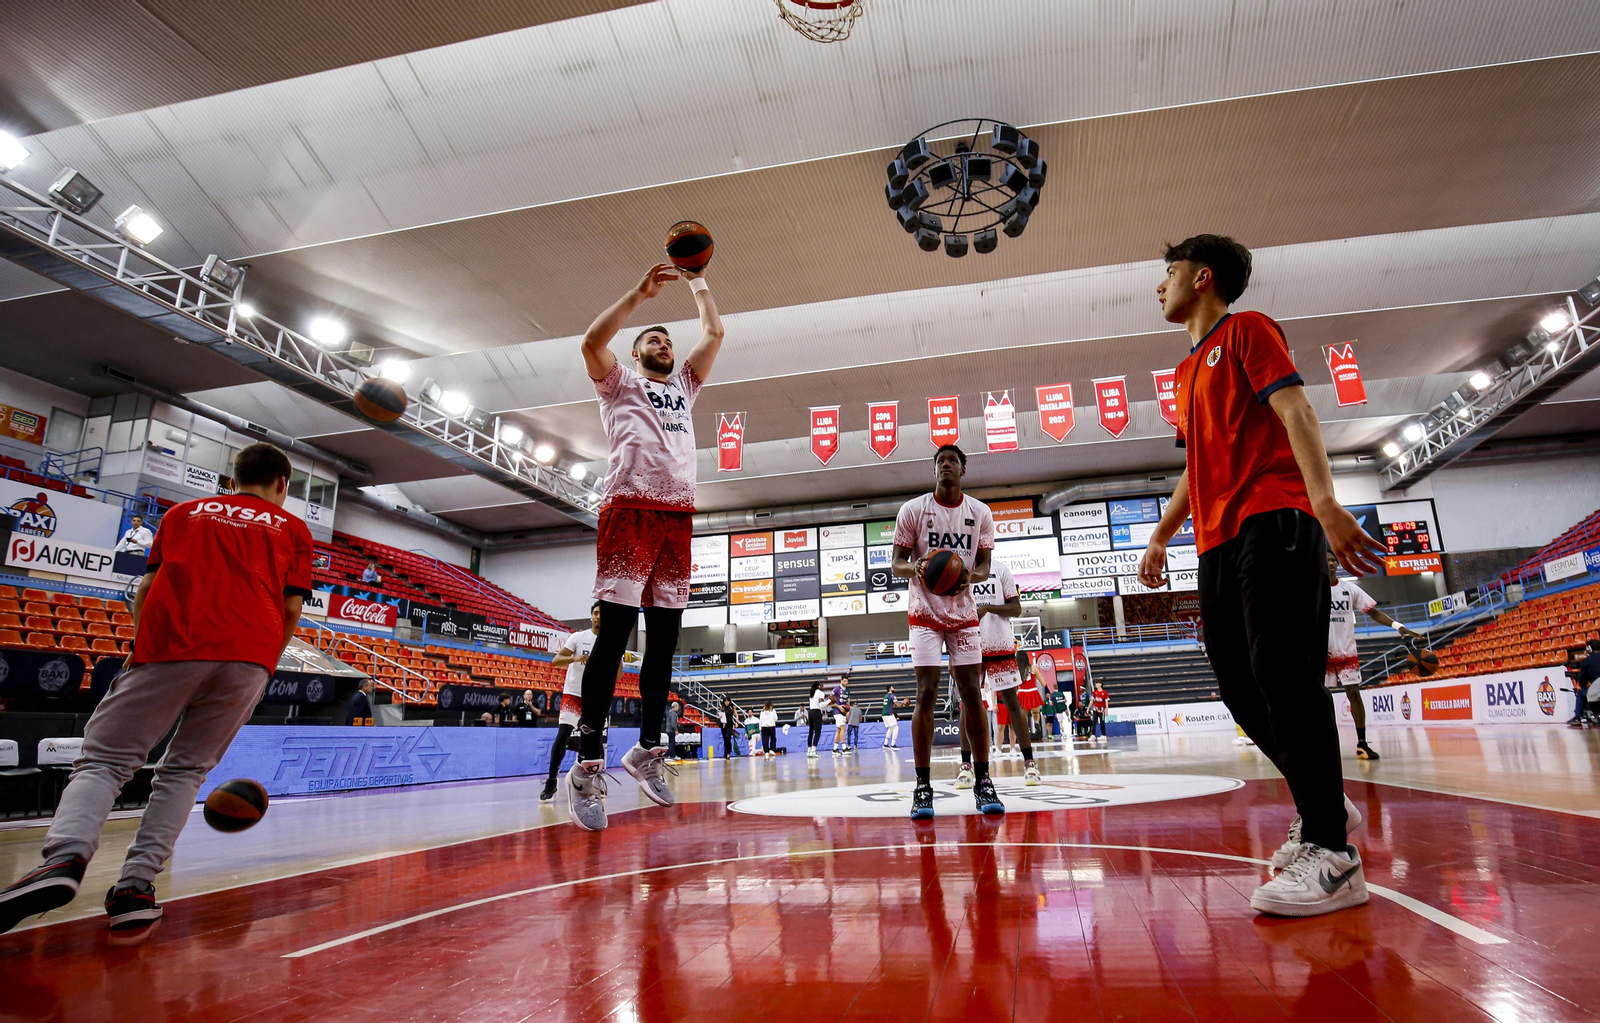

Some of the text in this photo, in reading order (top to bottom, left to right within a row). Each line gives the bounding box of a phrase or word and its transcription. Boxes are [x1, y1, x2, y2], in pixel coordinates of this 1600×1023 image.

[1046, 393, 1063, 402] LLIGA
[1102, 388, 1120, 397] LLIGA
[1160, 391, 1175, 400] CATAL
[647, 392, 686, 411] BAX
[1041, 401, 1071, 411] CATALANA
[1106, 399, 1119, 407] ACB
[933, 405, 953, 414] LLIGA
[817, 417, 832, 425] LLIGA
[876, 413, 891, 421] COPA
[937, 417, 950, 425] LEB
[1049, 416, 1066, 424] 2021
[813, 426, 837, 435] CATALANA
[873, 423, 883, 431] DEL
[187, 467, 216, 480] JUANOLA
[189, 502, 287, 528] JOYSAT
[1064, 509, 1102, 518] canonge
[18, 527, 46, 537] ANRESA
[996, 522, 1025, 534] GCT
[929, 532, 972, 549] BAXI
[1063, 533, 1108, 542] FRAMUN
[1388, 536, 1398, 544] 00
[1418, 534, 1428, 542] 00
[36, 545, 112, 572] AIGNEP
[1399, 558, 1440, 567] ESTRELLA
[777, 559, 815, 570] sensus
[1078, 565, 1117, 576] sarsa
[844, 572, 860, 580] GLS
[973, 584, 995, 595] AXI
[1020, 592, 1053, 600] CLARET
[1331, 601, 1349, 611] AXI
[472, 623, 508, 636] CAL SPAGUETTI
[778, 621, 809, 629] BAR
[40, 669, 69, 679] BAXI
[1486, 681, 1524, 706] BAXI
[1538, 692, 1556, 701] BAXI
[1373, 694, 1394, 712] BAXI
[1430, 699, 1470, 710] ESTRELLA DAMM
[1488, 708, 1527, 717] CLIMATIZACIÓN
[1186, 713, 1230, 723] Kouten.cat
[309, 773, 413, 790] EQUIPACIONES DEPORTIVAS
